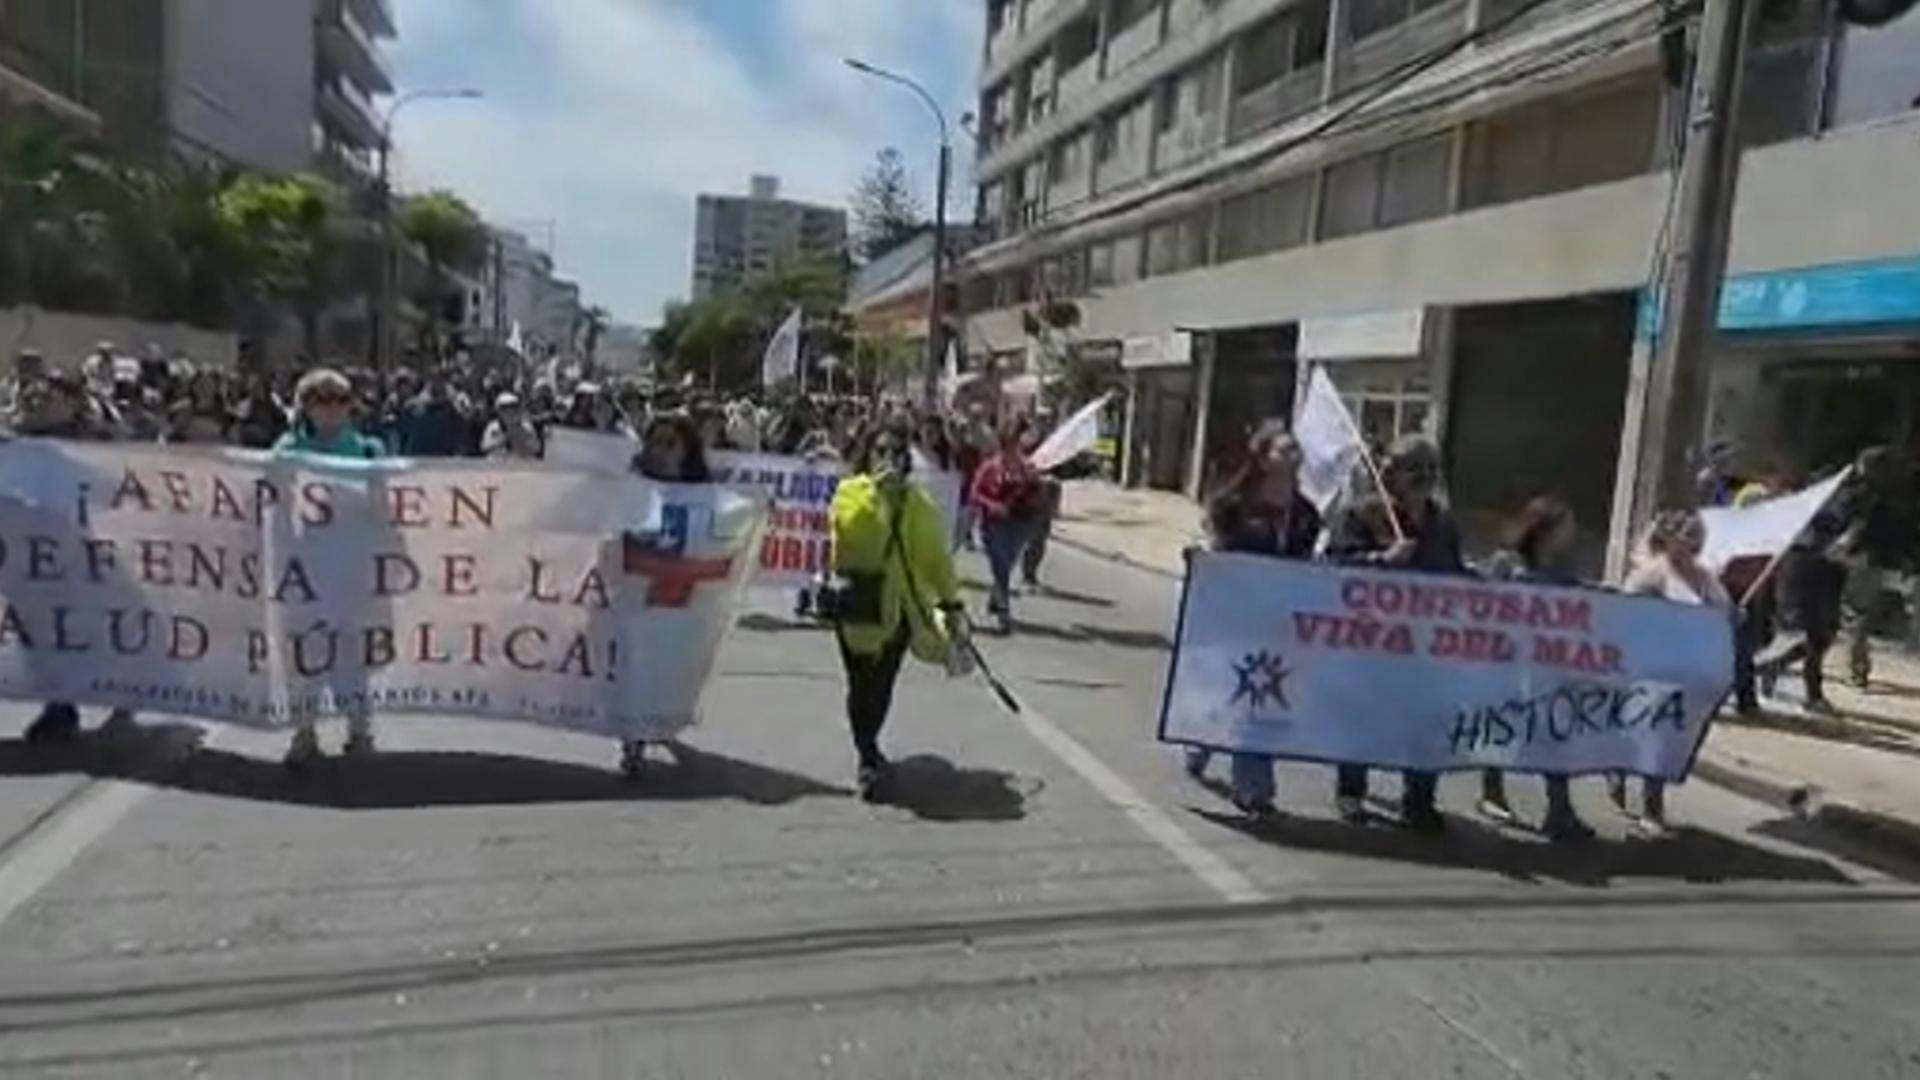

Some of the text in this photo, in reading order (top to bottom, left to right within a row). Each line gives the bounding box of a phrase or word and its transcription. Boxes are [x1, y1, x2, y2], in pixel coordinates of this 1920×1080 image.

[388, 484, 498, 529] EN
[373, 553, 479, 596] DE
[525, 554, 614, 608] LA
[1341, 577, 1593, 633] CONFUSAM
[246, 618, 619, 682] PÚBLICA!
[1292, 610, 1627, 676] VIÑA DEL MAR
